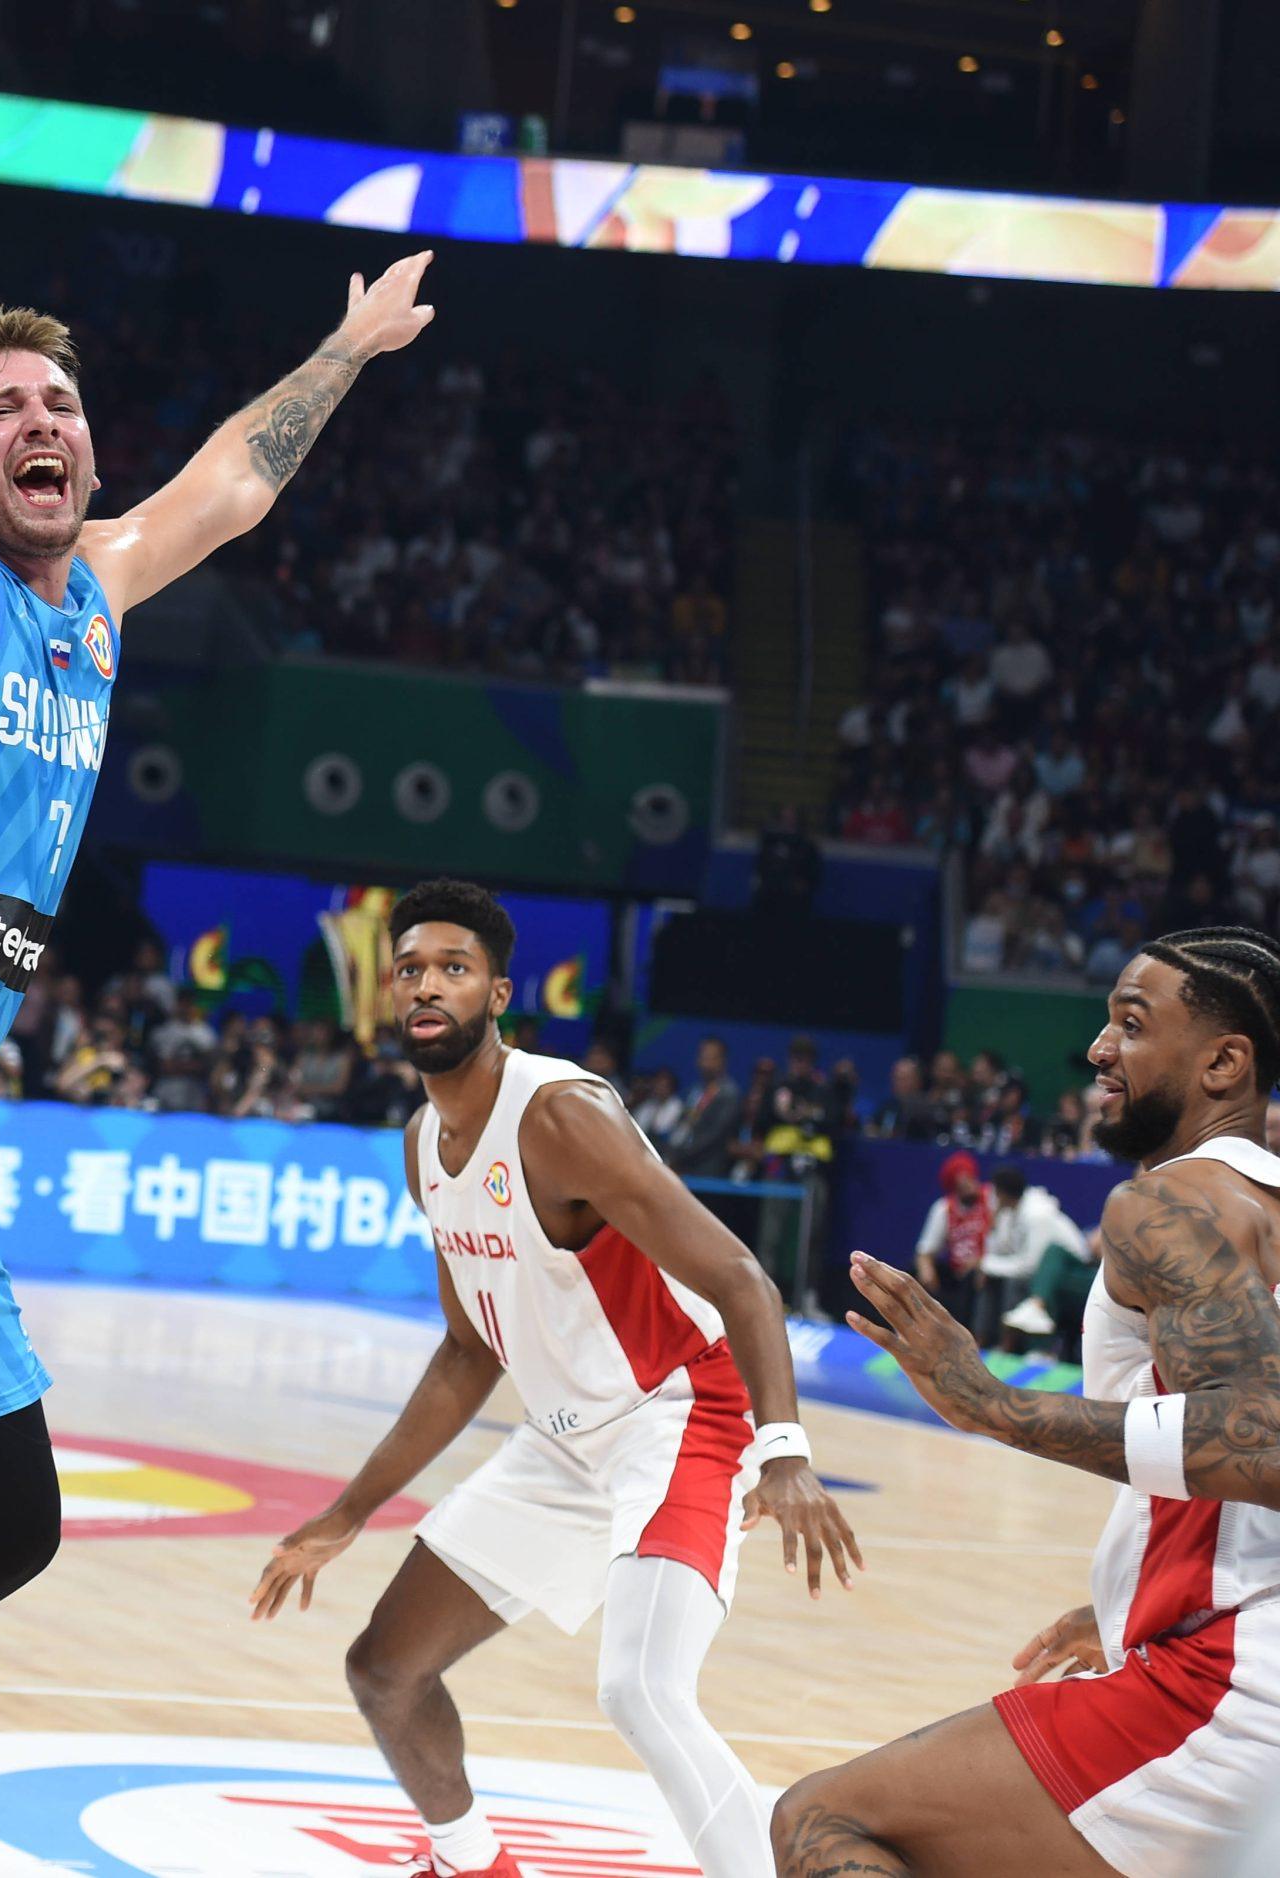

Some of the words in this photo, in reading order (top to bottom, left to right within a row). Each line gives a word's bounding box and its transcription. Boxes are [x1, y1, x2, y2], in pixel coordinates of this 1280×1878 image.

[49, 800, 72, 875] 7
[435, 1227, 517, 1262] CANADA
[478, 1290, 509, 1367] 11
